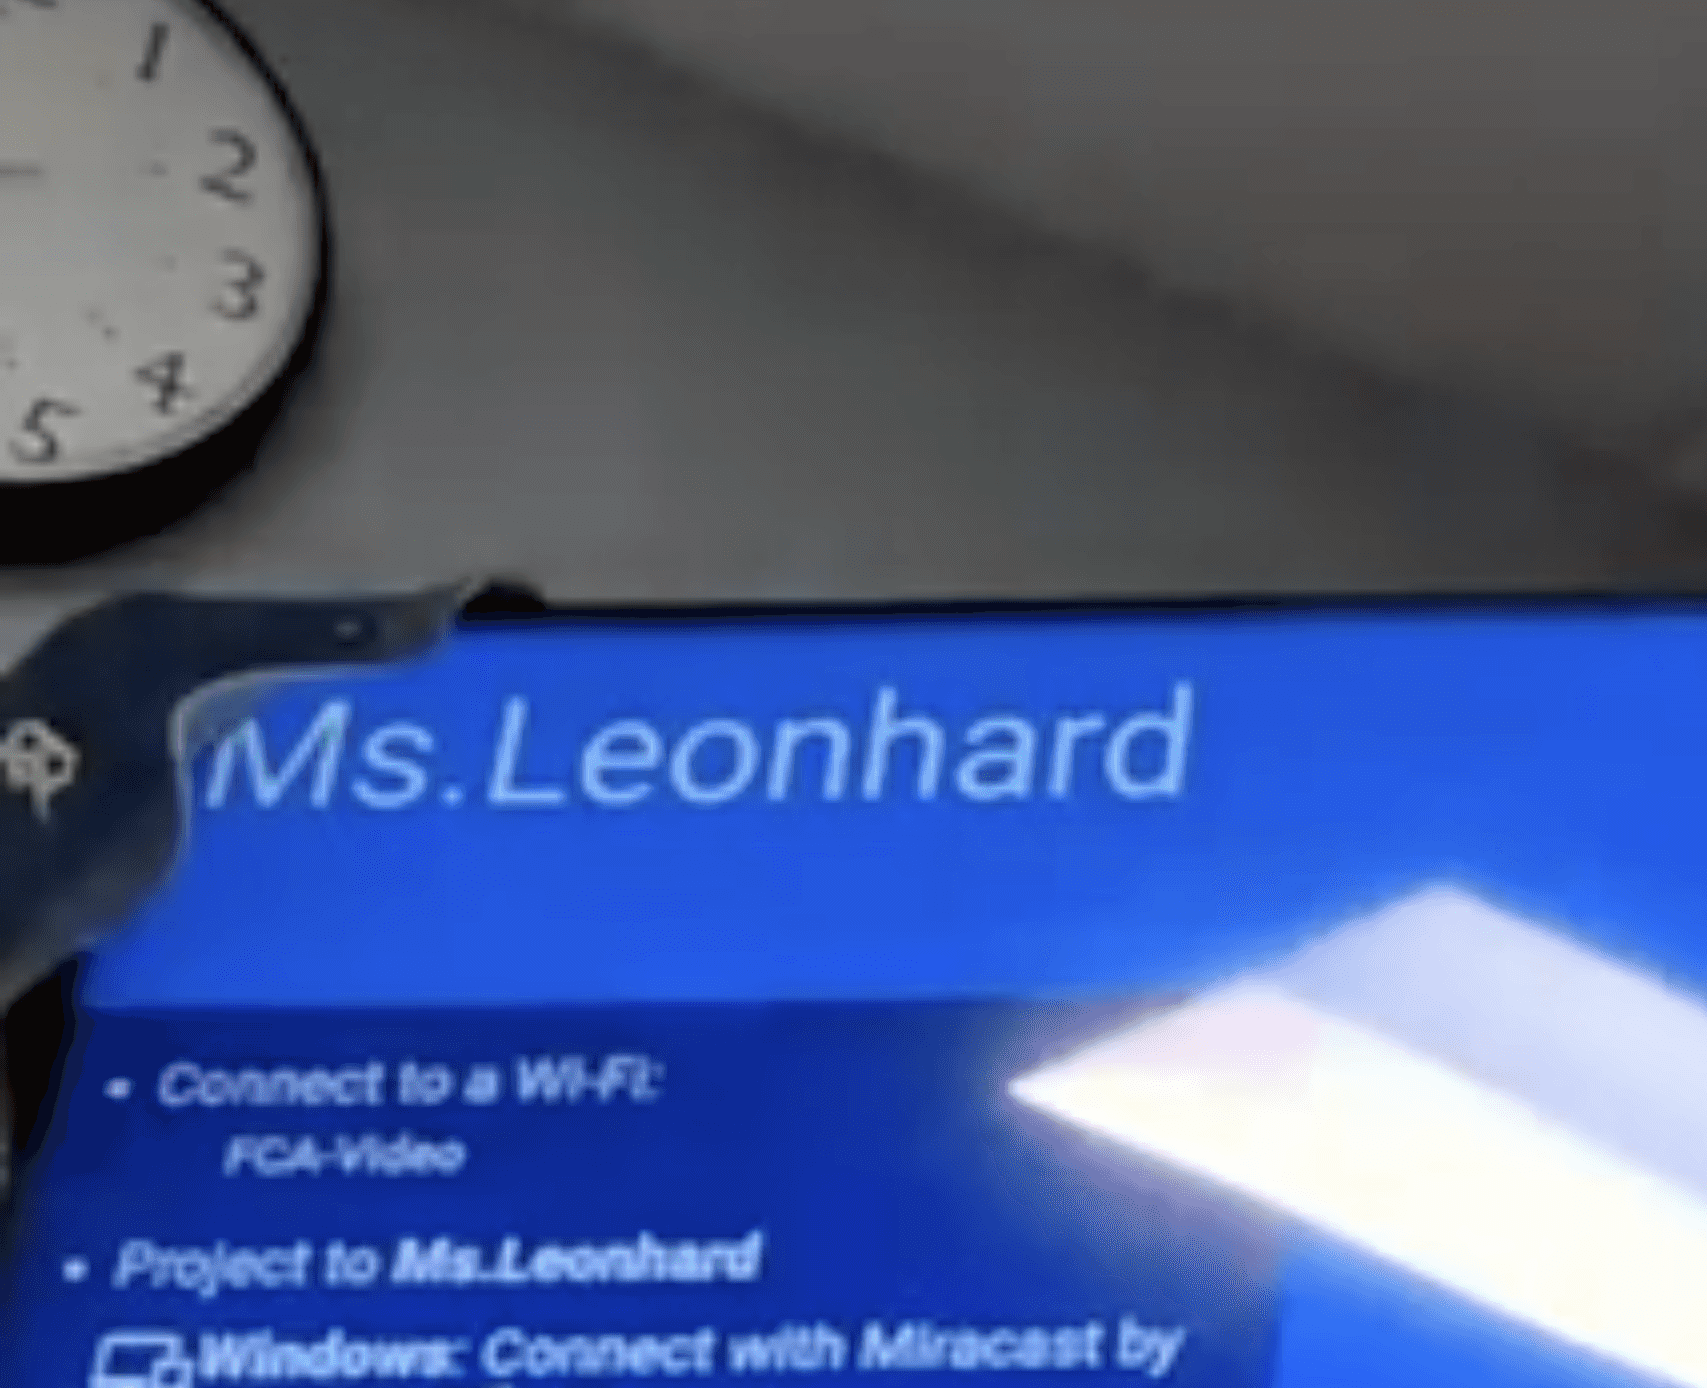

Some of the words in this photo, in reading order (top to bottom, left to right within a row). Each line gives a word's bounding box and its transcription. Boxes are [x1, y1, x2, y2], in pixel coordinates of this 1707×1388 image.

[133, 21, 171, 85] 1
[199, 126, 258, 206] 2
[206, 247, 264, 322] 3
[132, 350, 194, 416] 4
[7, 397, 80, 464] 5
[203, 678, 1196, 813] Ms.Leonhard
[155, 1054, 385, 1108] Connect
[398, 1057, 454, 1104] to
[461, 1063, 500, 1103] a
[220, 1132, 468, 1179] FCA-Video
[110, 1237, 311, 1299] Project
[325, 1238, 381, 1286] to
[389, 1228, 766, 1285] Ms.Leonhard
[197, 1325, 473, 1381] Windows:
[480, 1324, 718, 1379] Connect
[726, 1317, 849, 1374] with
[855, 1315, 1105, 1372] Miracast
[1115, 1312, 1187, 1379] by
